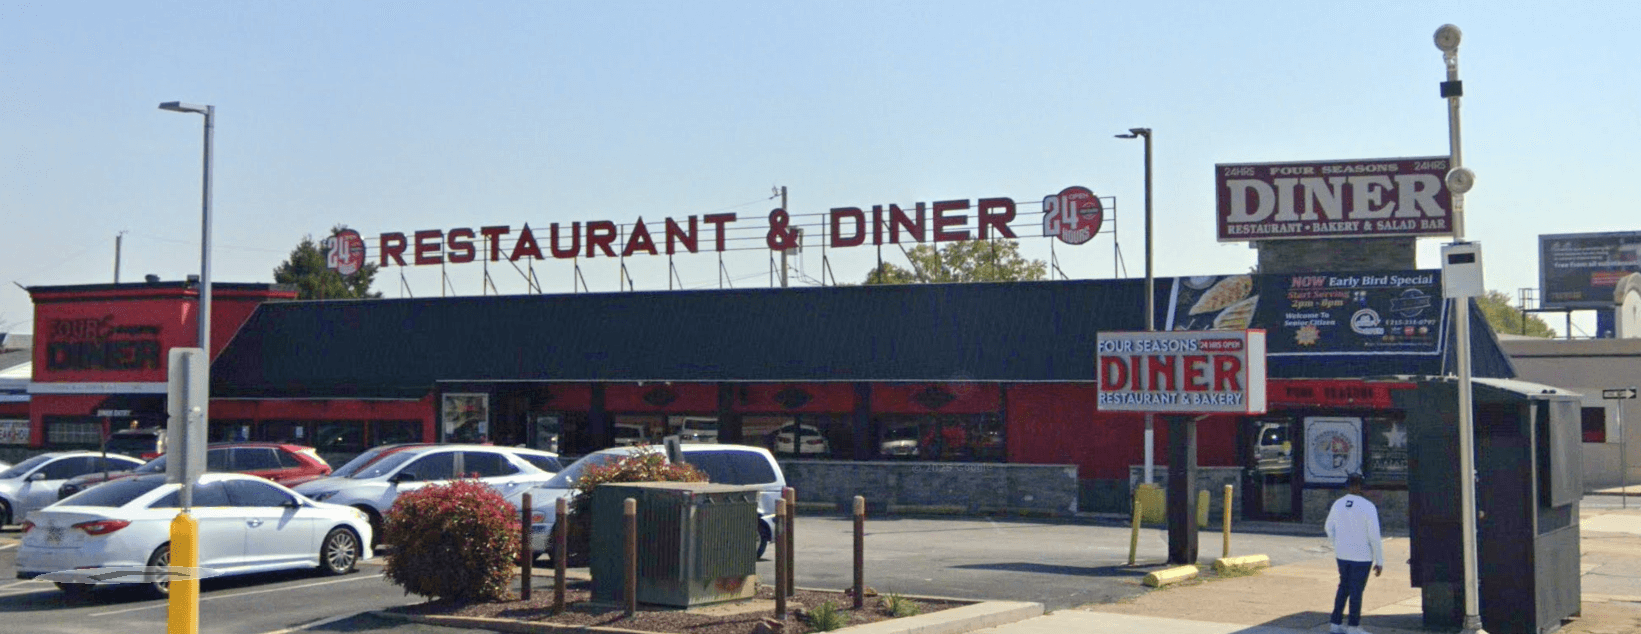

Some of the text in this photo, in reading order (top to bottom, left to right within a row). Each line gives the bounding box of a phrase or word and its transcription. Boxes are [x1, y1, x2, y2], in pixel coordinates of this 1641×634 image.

[1224, 167, 1255, 177] 24HRS
[1270, 163, 1399, 176] FOUR SEASONS
[1414, 161, 1446, 171] 24HRS
[1225, 173, 1446, 223] DINER
[1043, 195, 1080, 236] 24
[380, 197, 1019, 267] RESTAURANT & DINER
[1062, 225, 1090, 243] HOURS
[1227, 219, 1446, 235] RESTAURANT BAKERY & SALAD BAR
[327, 236, 351, 268] 24
[1291, 274, 1433, 289] NOW Early Bird Special
[1284, 319, 1308, 327] Senior
[1098, 338, 1198, 352] FOUR SEASONS
[1200, 341, 1208, 349] 24
[1223, 340, 1241, 349] OPEN
[46, 341, 162, 370] DINER
[1100, 355, 1242, 392] DINER
[1099, 393, 1242, 406] RESTAURANT & BAKERY
